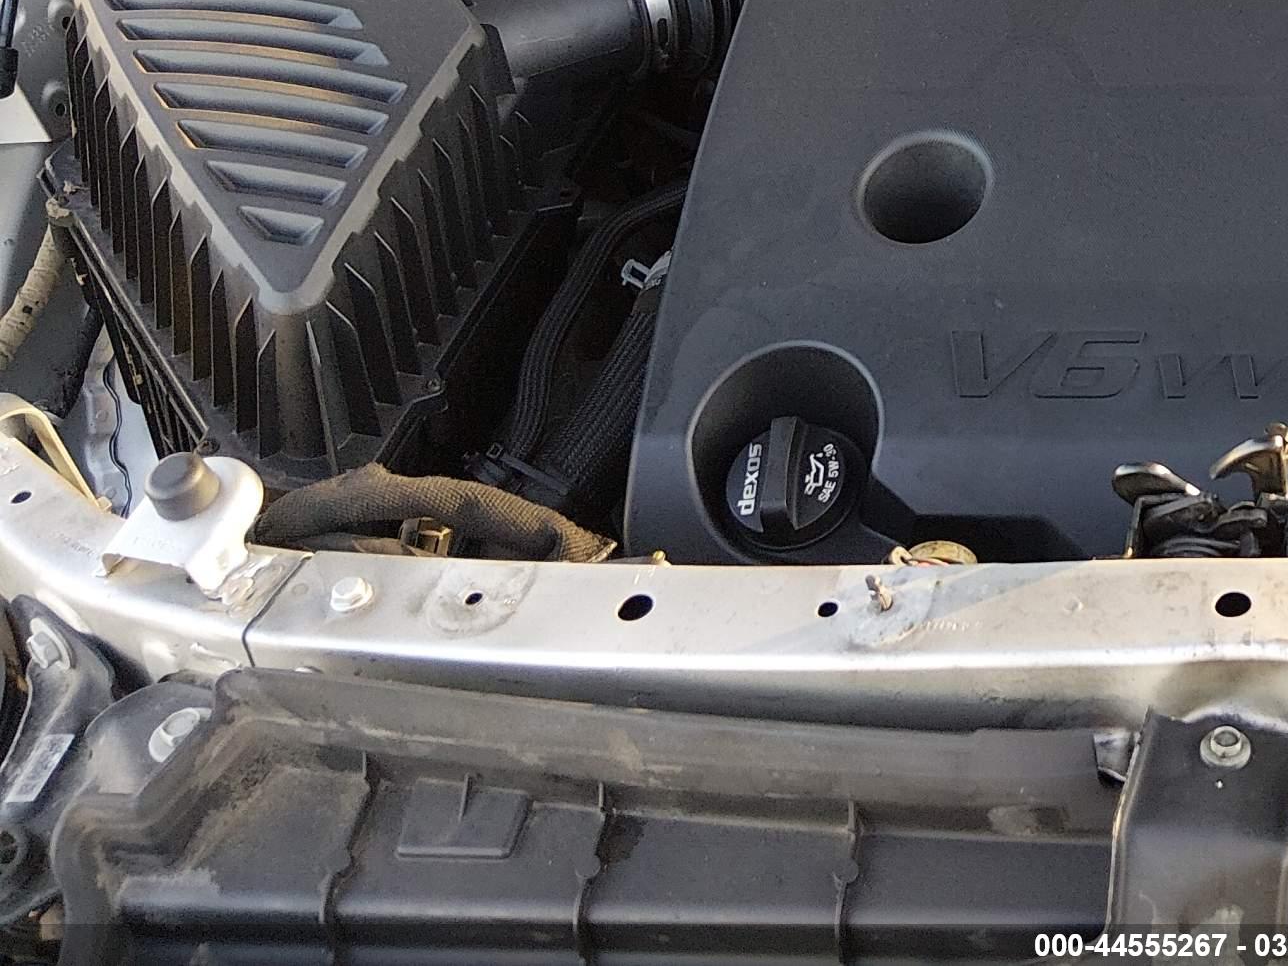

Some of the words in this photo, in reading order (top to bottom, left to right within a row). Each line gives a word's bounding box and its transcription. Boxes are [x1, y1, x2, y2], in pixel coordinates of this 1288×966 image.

[950, 330, 1148, 399] V6
[737, 444, 762, 516] dexos
[824, 443, 840, 479] 5W-30
[818, 480, 837, 503] SAE
